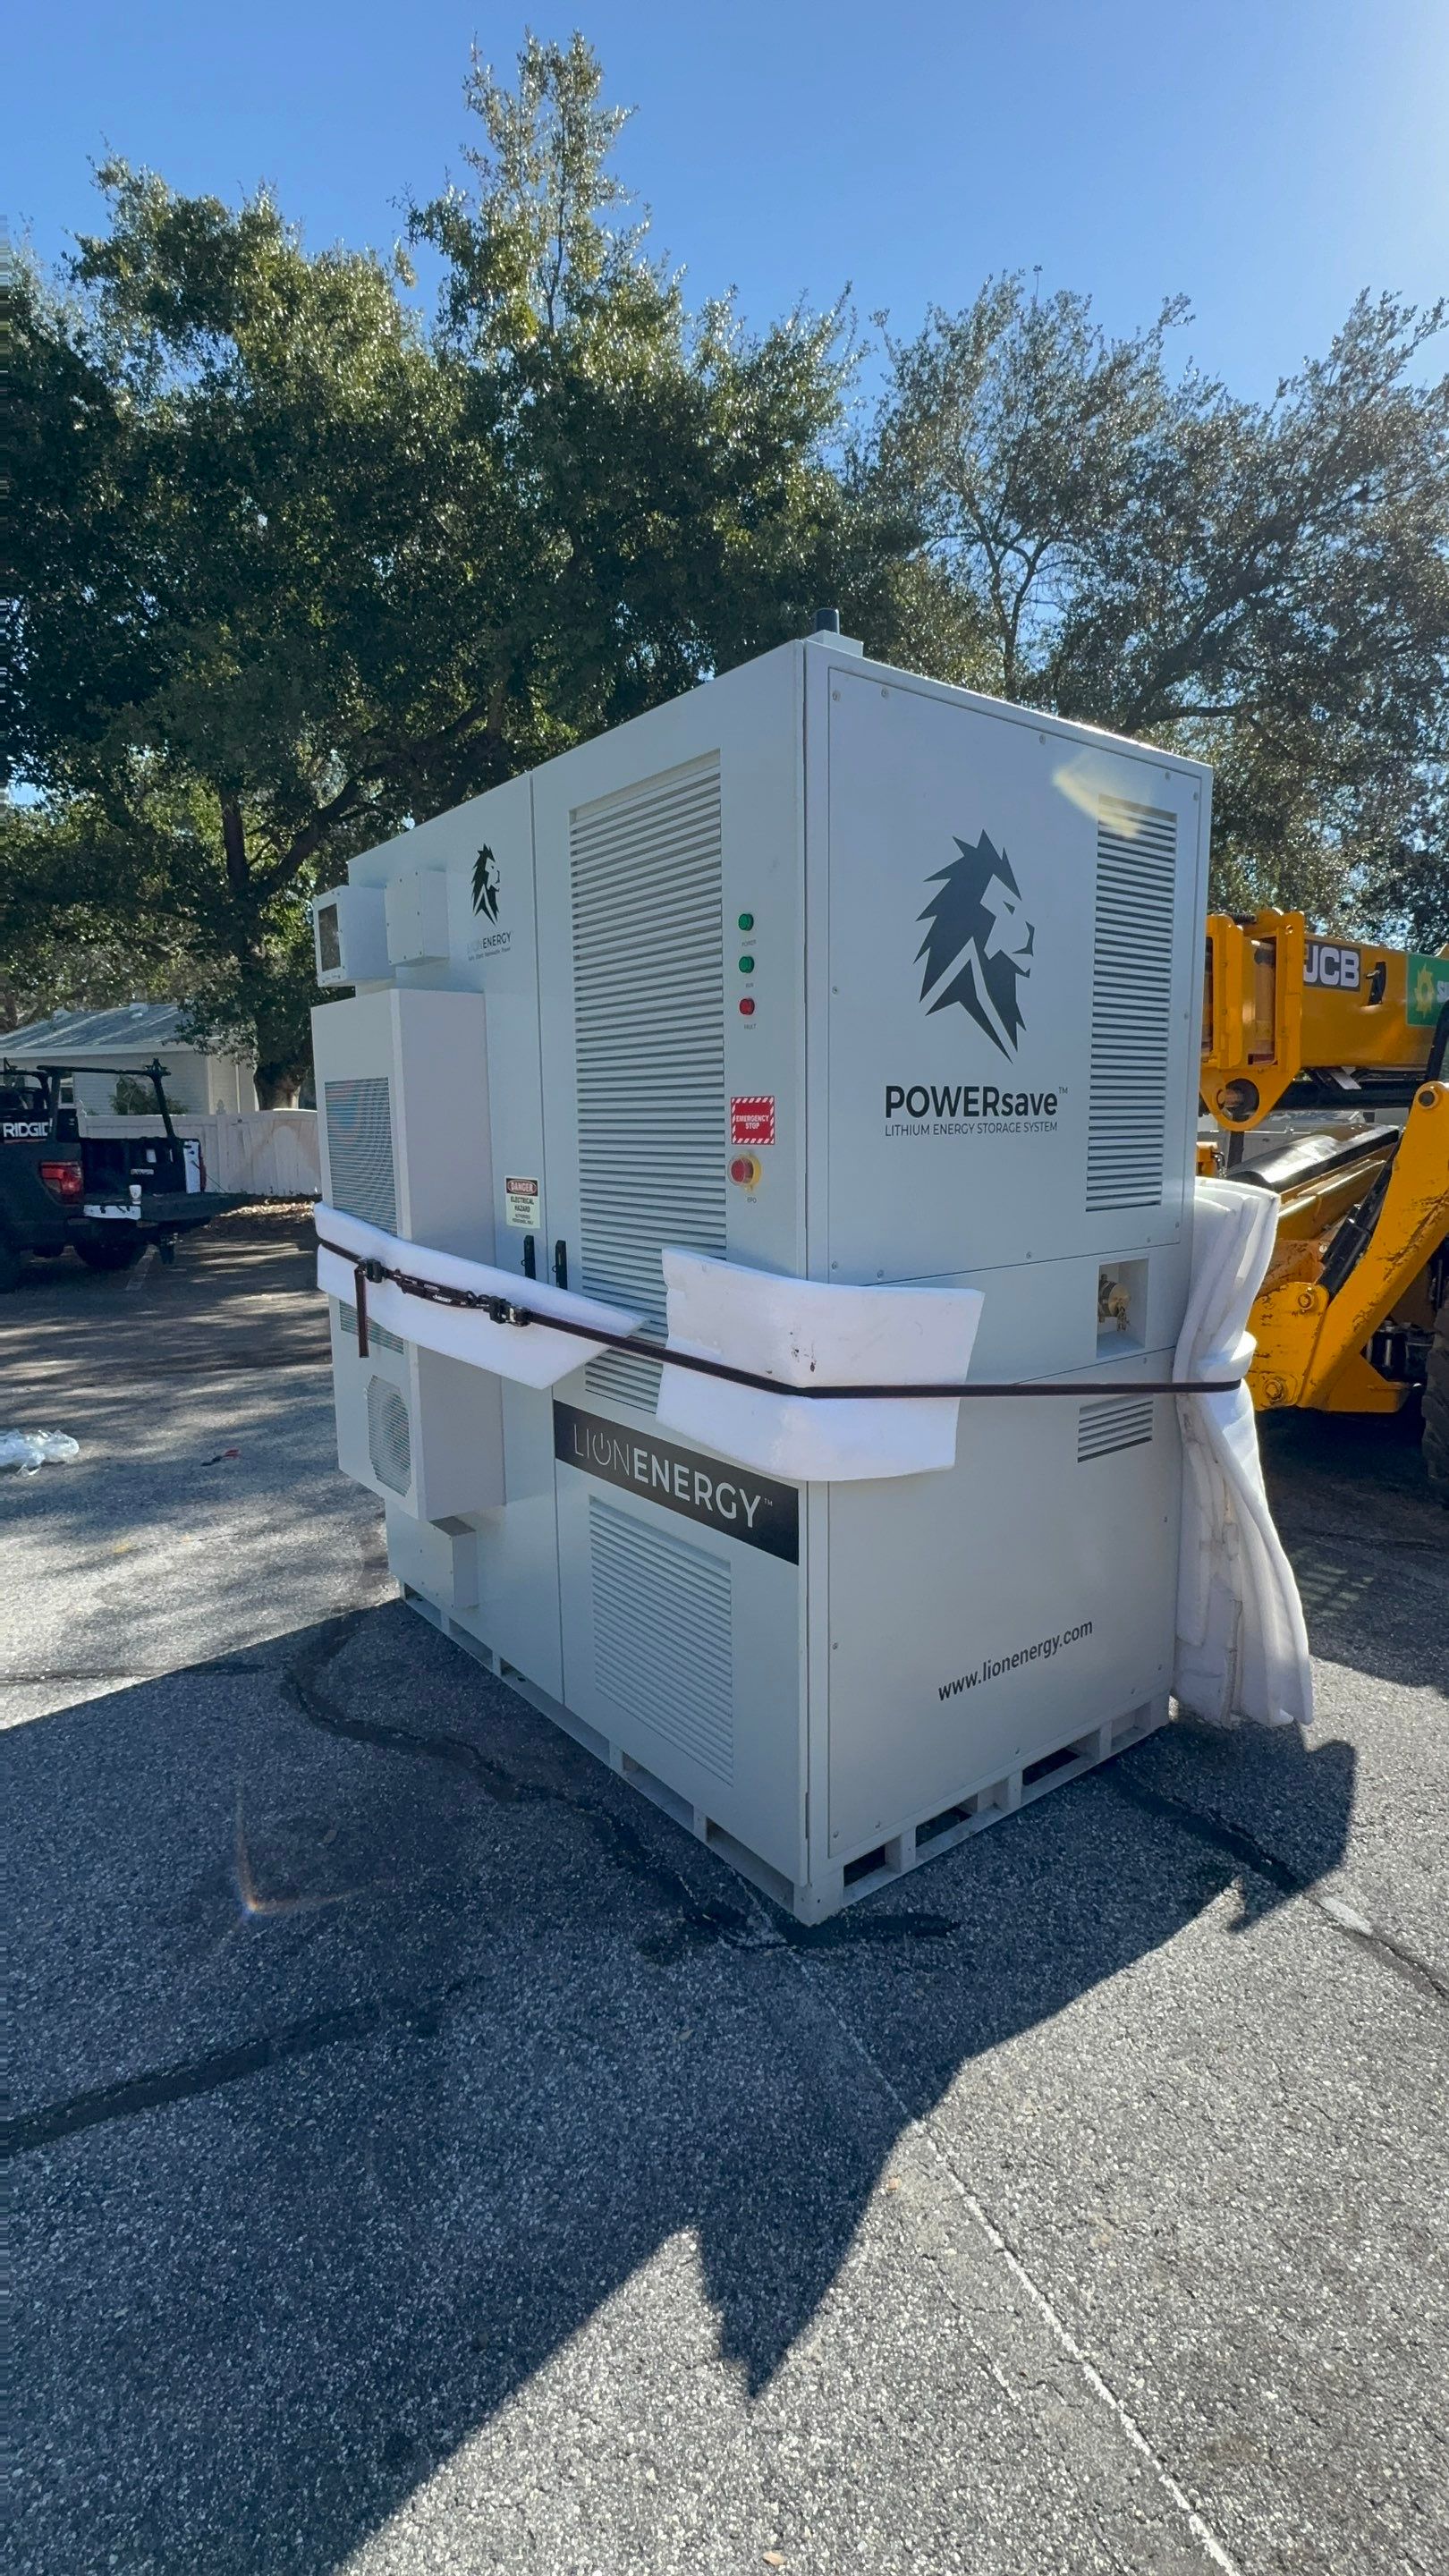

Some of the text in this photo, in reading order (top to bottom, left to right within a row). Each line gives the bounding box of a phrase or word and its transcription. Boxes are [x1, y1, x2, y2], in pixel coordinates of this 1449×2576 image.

[1303, 945, 1359, 987] JCB
[735, 1114, 769, 1123] EMERGENCY
[745, 1122, 760, 1130] STOP
[885, 1121, 1058, 1137] LITHIUM ENERGY STORAGE SYSTEM
[511, 1182, 533, 1191] DANGER
[938, 1621, 1093, 1701] www.lionenergy.com
